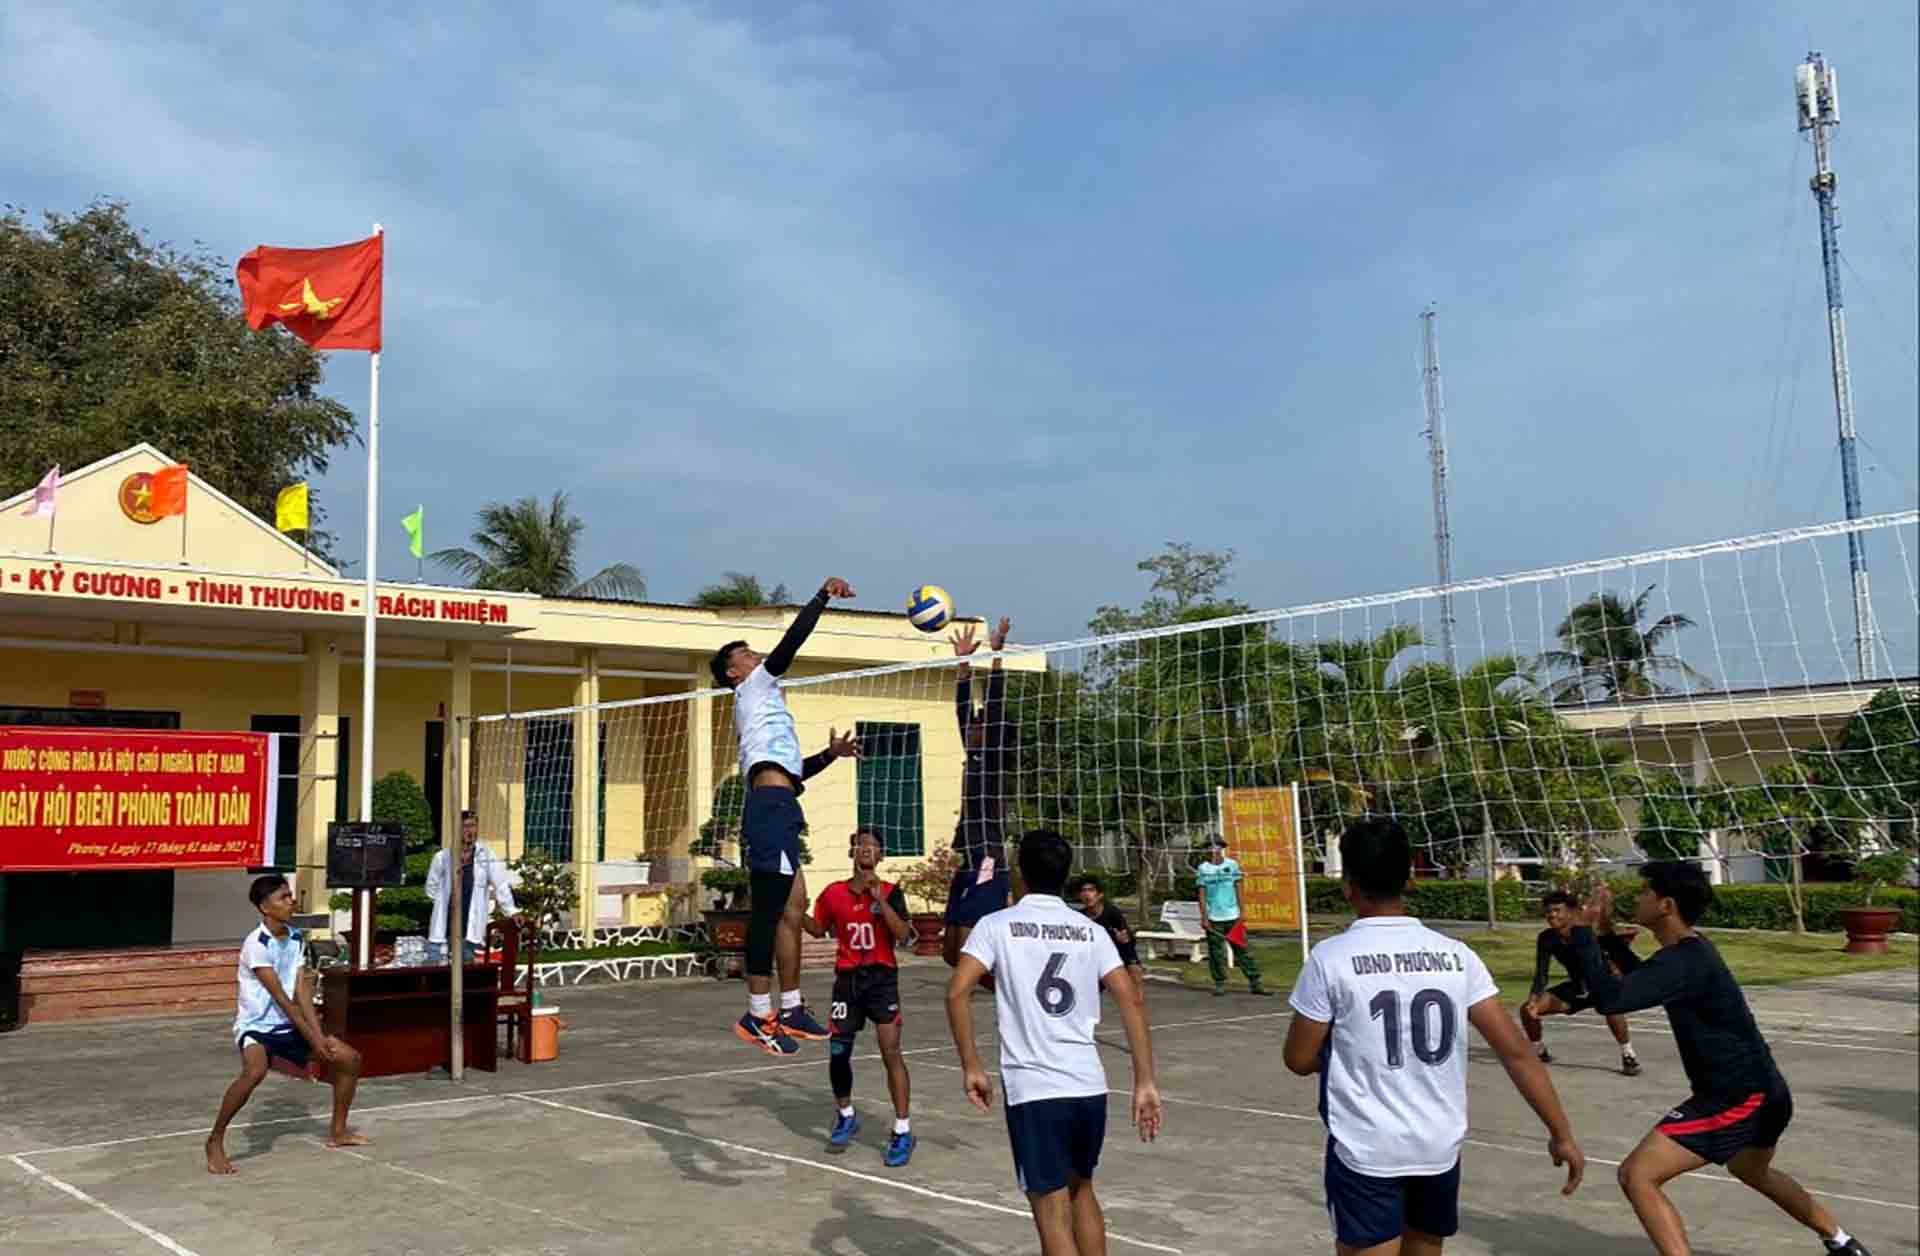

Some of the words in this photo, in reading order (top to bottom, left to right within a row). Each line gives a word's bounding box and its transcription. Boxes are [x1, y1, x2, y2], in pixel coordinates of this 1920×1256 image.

[73, 571, 161, 599] CƯƠNG
[186, 577, 243, 605] TÌNH
[250, 585, 345, 612] THƯƠNG
[376, 592, 436, 618] RÁCH
[441, 598, 508, 624] NHIỆM
[39, 746, 71, 776] CỘNG
[42, 782, 72, 836] HỘI
[75, 783, 114, 827] BIÊN
[117, 782, 171, 827] PHÒNG
[175, 783, 216, 827] TOÀN
[218, 784, 251, 827] DÂN
[847, 922, 875, 950] 20
[1035, 952, 1076, 1017] 6
[1351, 953, 1392, 976] UBND
[832, 1002, 848, 1019] 20
[1369, 988, 1457, 1069] 10
